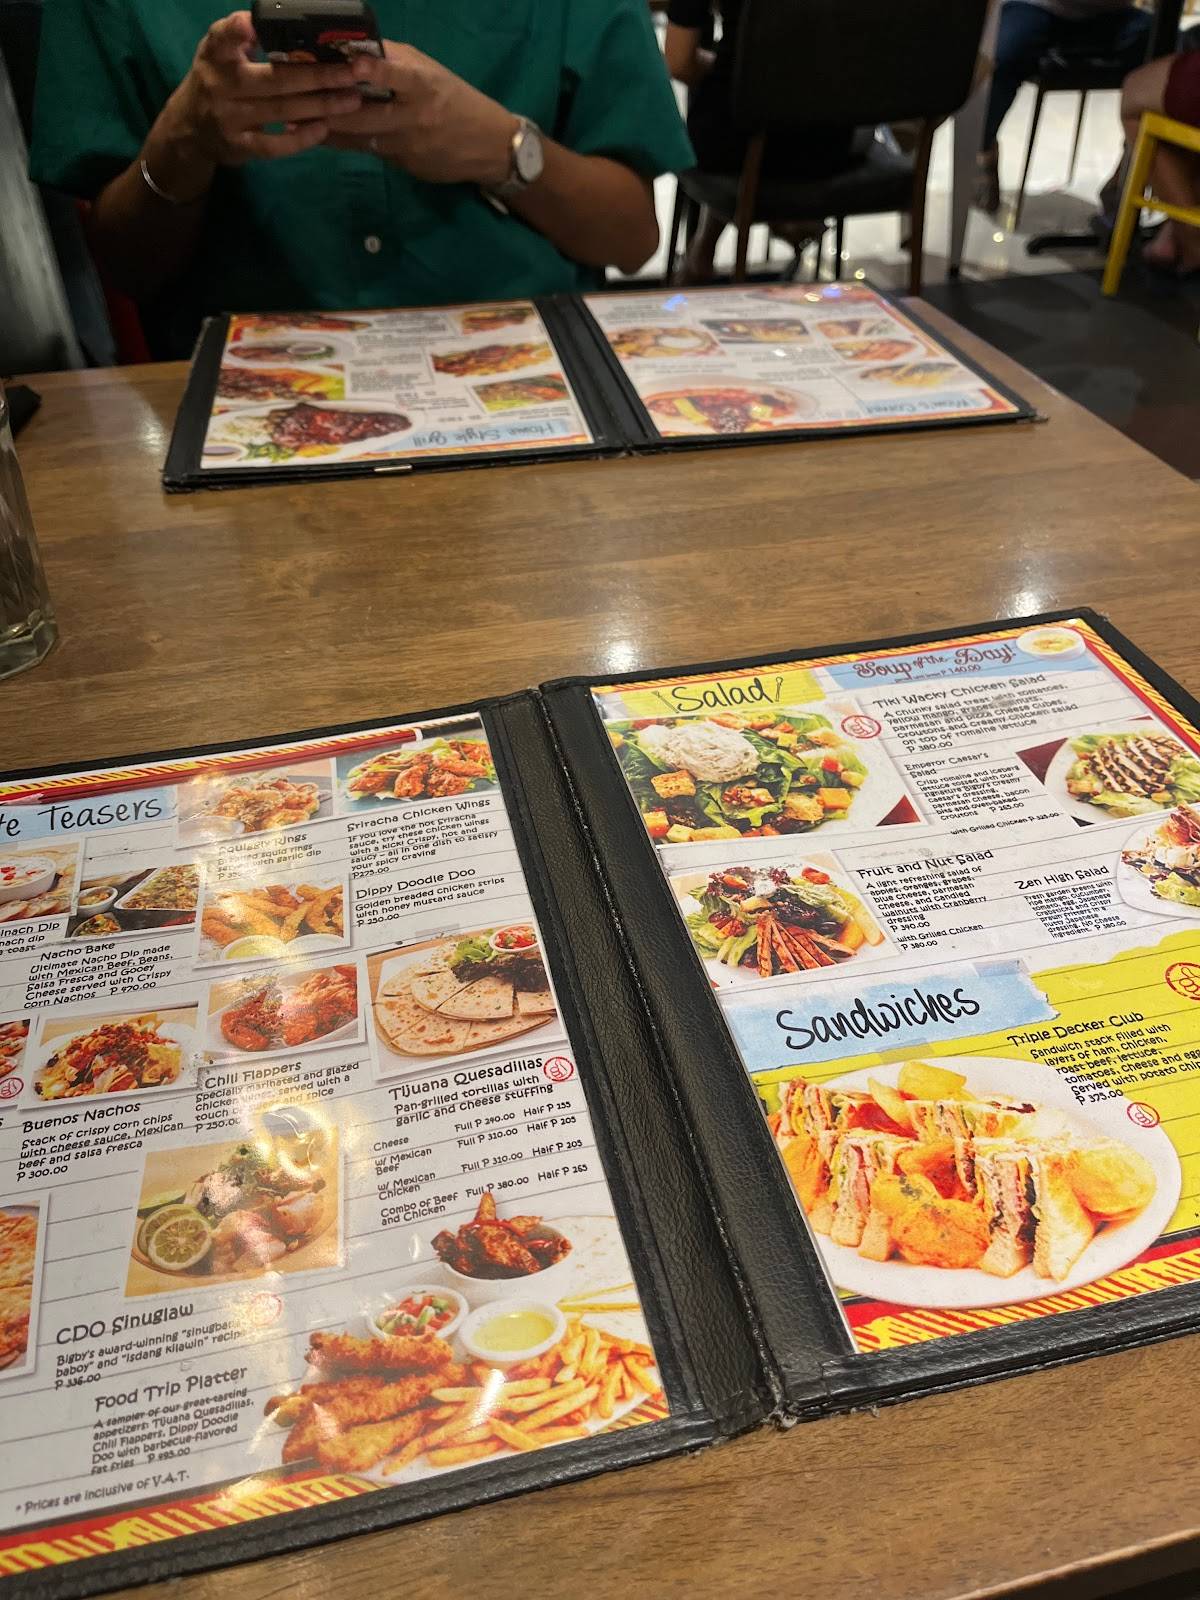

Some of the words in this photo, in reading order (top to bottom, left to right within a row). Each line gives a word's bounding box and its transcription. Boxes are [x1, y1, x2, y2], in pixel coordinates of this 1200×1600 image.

[853, 661, 912, 679] Soup
[672, 677, 774, 711] Salad
[872, 697, 901, 709] Tiki
[903, 690, 948, 704] Wacky
[950, 680, 1006, 698] Chicken
[1008, 674, 1046, 689] Salad
[904, 760, 946, 771] Emperor
[909, 768, 937, 779] Salad
[37, 799, 162, 830] Teasers
[347, 816, 399, 832] Sriracha
[402, 804, 453, 821] Chicken
[455, 799, 491, 810] Wings
[378, 827, 398, 837] love
[401, 849, 437, 861] craving
[856, 866, 894, 879] Fruit
[897, 861, 922, 873] and
[924, 856, 954, 870] Nut
[956, 849, 994, 865] Salad
[356, 884, 394, 900] Dippy
[397, 873, 445, 891] Doodle
[448, 868, 476, 880] Doo
[899, 872, 945, 884] refreshing
[932, 882, 975, 895] parmesan
[1014, 878, 1042, 890] Zen
[1043, 871, 1073, 886] High
[1075, 865, 1110, 880] Salad
[355, 899, 391, 912] Golden
[394, 889, 434, 903] breaded
[436, 882, 476, 895] chicken
[477, 877, 505, 887] strips
[356, 910, 379, 919] with
[382, 903, 411, 915] honey
[413, 895, 454, 907] mustard
[456, 888, 485, 898] sauce
[921, 903, 941, 912] with
[38, 922, 60, 932] Dip
[886, 913, 926, 925] dressing
[948, 924, 984, 935] Chicken
[30, 960, 78, 974] Ultimate
[81, 953, 117, 966] Nacho
[120, 949, 140, 960] Dip
[142, 945, 171, 956] made
[40, 947, 82, 961] Nacho
[84, 942, 116, 954] Bake
[25, 987, 68, 1000] Cheese
[69, 981, 106, 993] served
[109, 976, 134, 986] with
[137, 970, 171, 982] Crispy
[26, 981, 55, 992] Salsa
[58, 974, 95, 986] Fresca
[97, 970, 118, 980] and
[120, 964, 155, 976] Gooey
[28, 972, 53, 981] with
[57, 964, 104, 978] Mexican
[23, 999, 51, 1009] corn
[53, 991, 96, 1005] Nachos
[776, 988, 980, 1050] Sandwiches
[1007, 1029, 1051, 1047] Triple
[1053, 1019, 1105, 1039] Decker
[1109, 1011, 1144, 1027] Club
[1030, 1041, 1083, 1060] Sandwich
[1085, 1035, 1114, 1048] stack
[1116, 1029, 1143, 1042] filled
[1145, 1023, 1172, 1034] with
[303, 1071, 323, 1081] and
[326, 1062, 359, 1076] glazed
[1043, 1055, 1076, 1067] layers
[1055, 1063, 1086, 1075] roast
[1121, 1059, 1160, 1073] cheese
[1161, 1054, 1182, 1065] and
[205, 1073, 238, 1090] Chili
[242, 1062, 302, 1082] Flappers
[316, 1076, 341, 1088] with
[388, 1078, 449, 1101] Tijuana
[453, 1057, 544, 1085] Quesadillas
[1071, 1080, 1111, 1096] Served
[1113, 1074, 1139, 1086] with
[1139, 1065, 1177, 1080] potato
[394, 1091, 459, 1115] Pan-grilled
[461, 1081, 510, 1098] tortillas
[513, 1075, 540, 1087] with
[396, 1110, 430, 1127] garlic
[434, 1105, 456, 1117] and
[459, 1094, 501, 1111] cheese
[505, 1084, 554, 1102] stuffing
[1088, 1089, 1124, 1103] 375.00
[21, 1135, 56, 1150] Stack
[59, 1131, 73, 1141] of
[76, 1123, 110, 1137] crispy
[112, 1119, 141, 1130] corn
[142, 1112, 174, 1125] chips
[22, 1114, 79, 1134] Buenos
[83, 1102, 141, 1122] Nachos
[454, 1119, 474, 1132] Full
[523, 1106, 545, 1118] Half
[20, 1147, 46, 1159] with
[50, 1139, 91, 1154] cheese
[134, 1121, 184, 1138] Mexican
[373, 1137, 409, 1151] Cheese
[457, 1135, 476, 1149] Full
[527, 1120, 548, 1133] Half
[18, 1157, 47, 1170] beef
[49, 1153, 71, 1165] and
[74, 1148, 102, 1160] salsa
[104, 1139, 143, 1155] fresca
[390, 1148, 432, 1164] Mexican
[28, 1165, 68, 1179] 300.00
[375, 1163, 400, 1175] Beef
[466, 1184, 485, 1198] Full
[537, 1169, 560, 1182] Half
[380, 1202, 417, 1218] Combo
[434, 1192, 459, 1206] Beef
[381, 1215, 401, 1226] and
[403, 1204, 446, 1222] Chicken
[56, 1321, 105, 1345] CDO
[111, 1303, 194, 1336] Sinuglaw
[56, 1348, 95, 1366] Bigby's
[98, 1332, 179, 1357] award-winning
[97, 1357, 118, 1369] and
[95, 1389, 138, 1412] Food
[143, 1381, 181, 1401] Trip
[186, 1367, 248, 1392] Platter
[24, 1497, 60, 1514] Prices
[63, 1493, 82, 1504] are
[84, 1483, 133, 1501] inclusive
